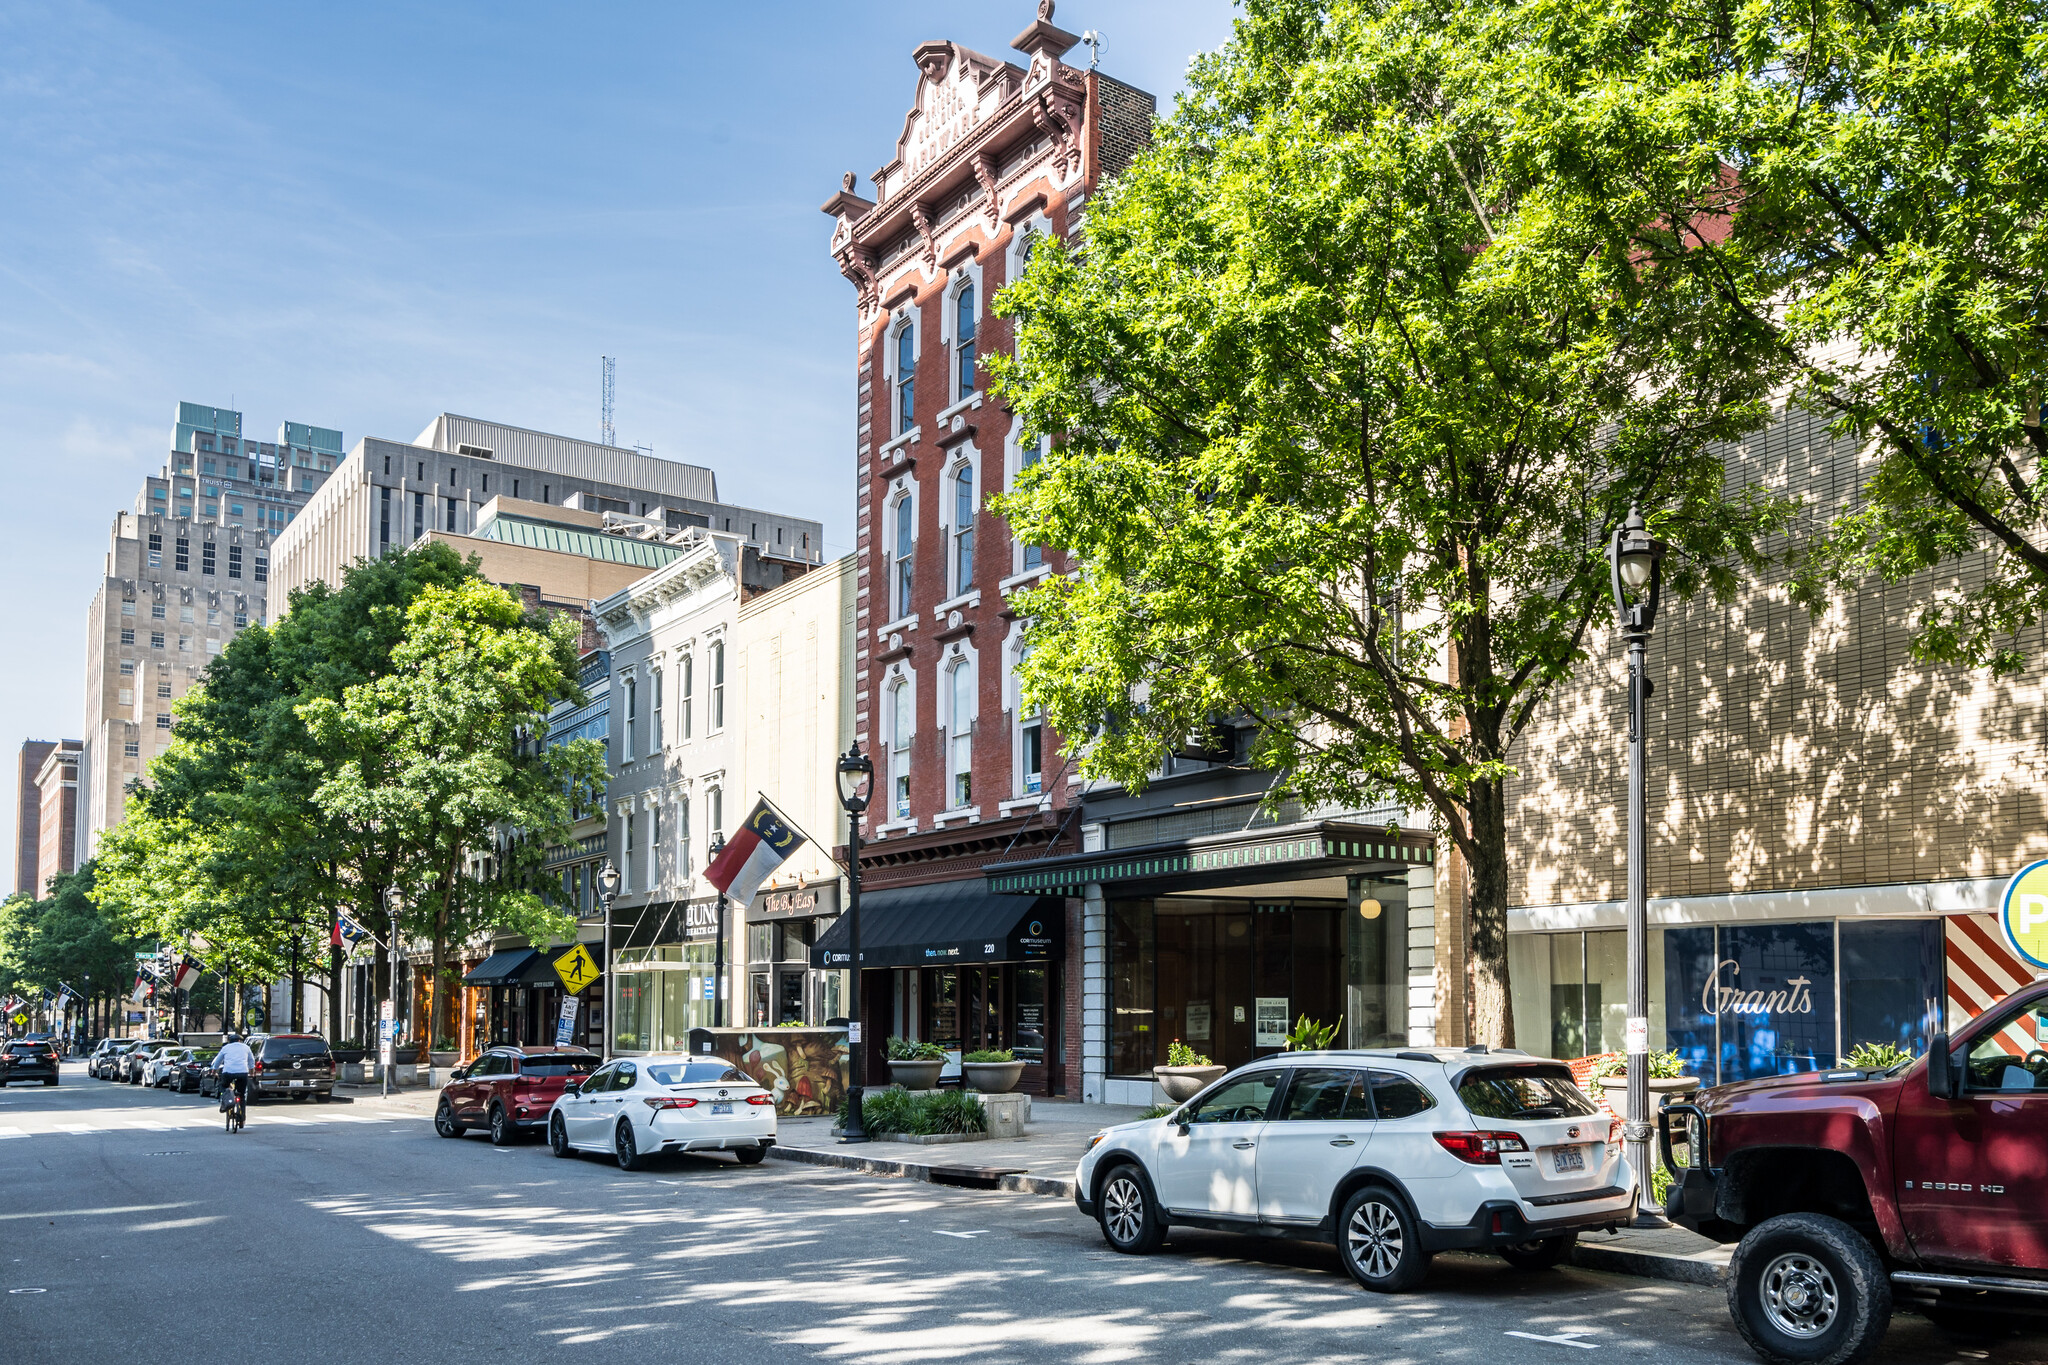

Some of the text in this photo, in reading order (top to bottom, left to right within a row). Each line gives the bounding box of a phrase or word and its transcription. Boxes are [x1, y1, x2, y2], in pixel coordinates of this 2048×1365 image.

[901, 103, 980, 184] HARDWARE
[202, 478, 223, 486] TRUIST
[765, 892, 816, 916] The Big Easy
[2020, 893, 2048, 934] P
[984, 944, 994, 954] 220
[1702, 959, 1812, 1016] Grants
[1922, 1182, 2004, 1194] 2500 HD
